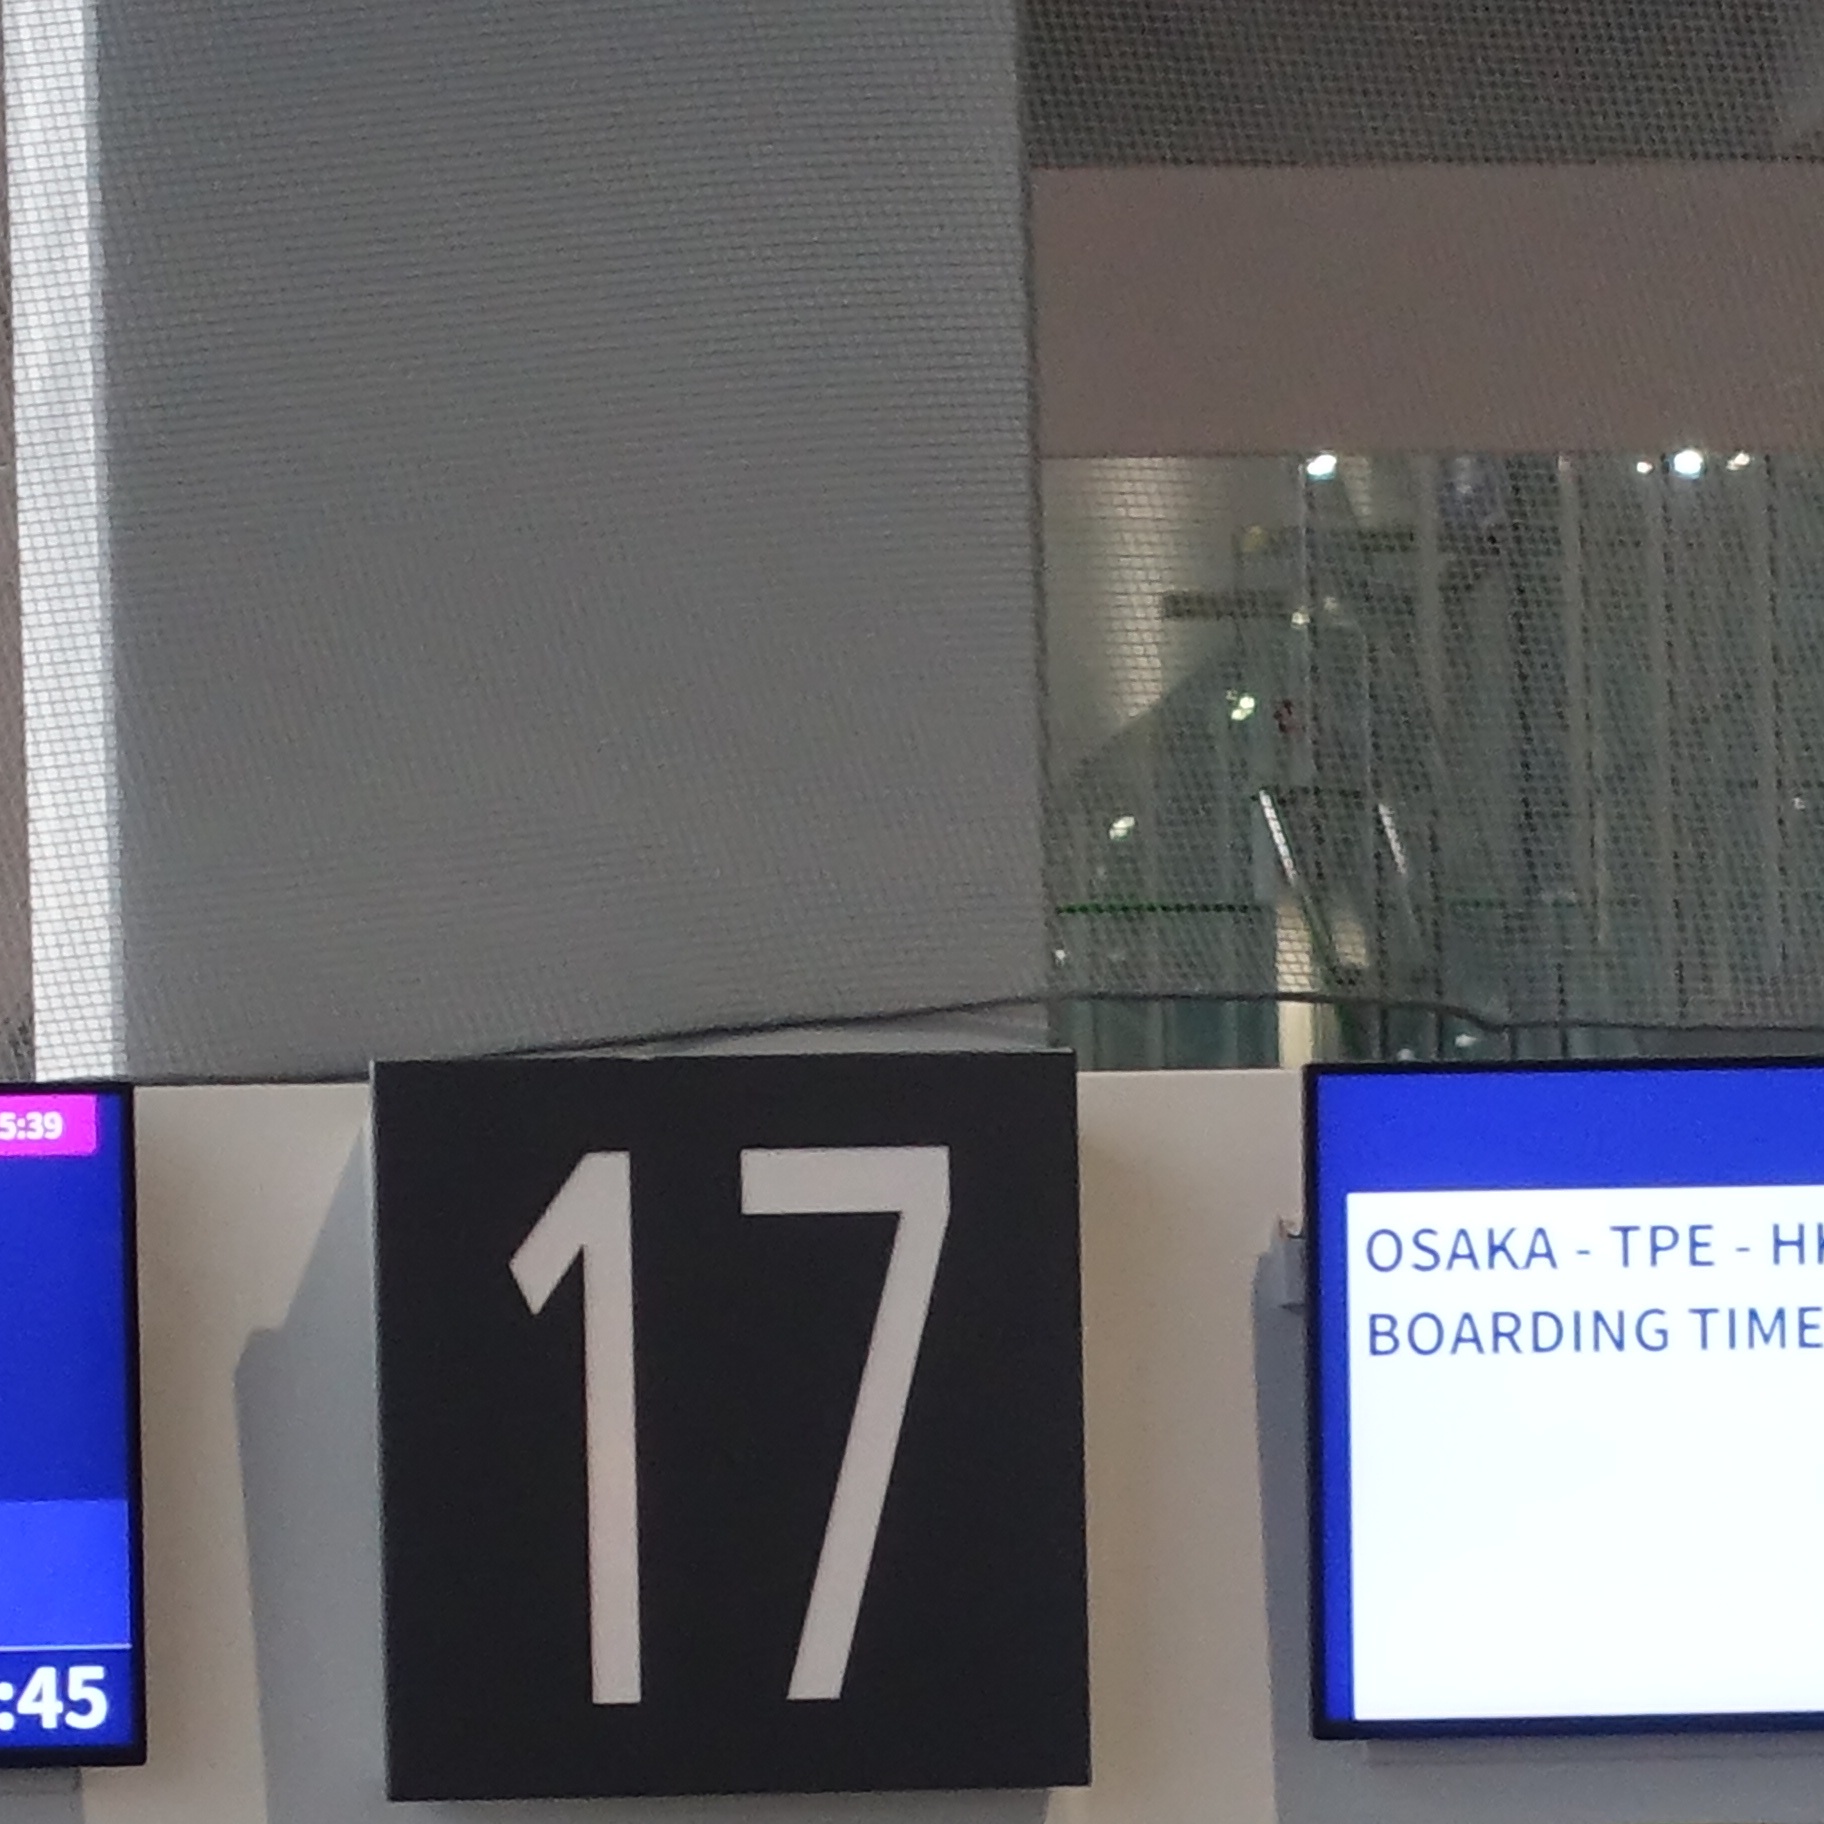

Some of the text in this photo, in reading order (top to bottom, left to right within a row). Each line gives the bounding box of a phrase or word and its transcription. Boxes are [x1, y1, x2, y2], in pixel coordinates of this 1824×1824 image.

[1365, 1228, 1558, 1274] OSAKA
[1610, 1223, 1715, 1268] TPE
[1367, 1306, 1669, 1357] BOARDING
[1689, 1304, 1824, 1352] TIME
[509, 1144, 951, 1706] 17
